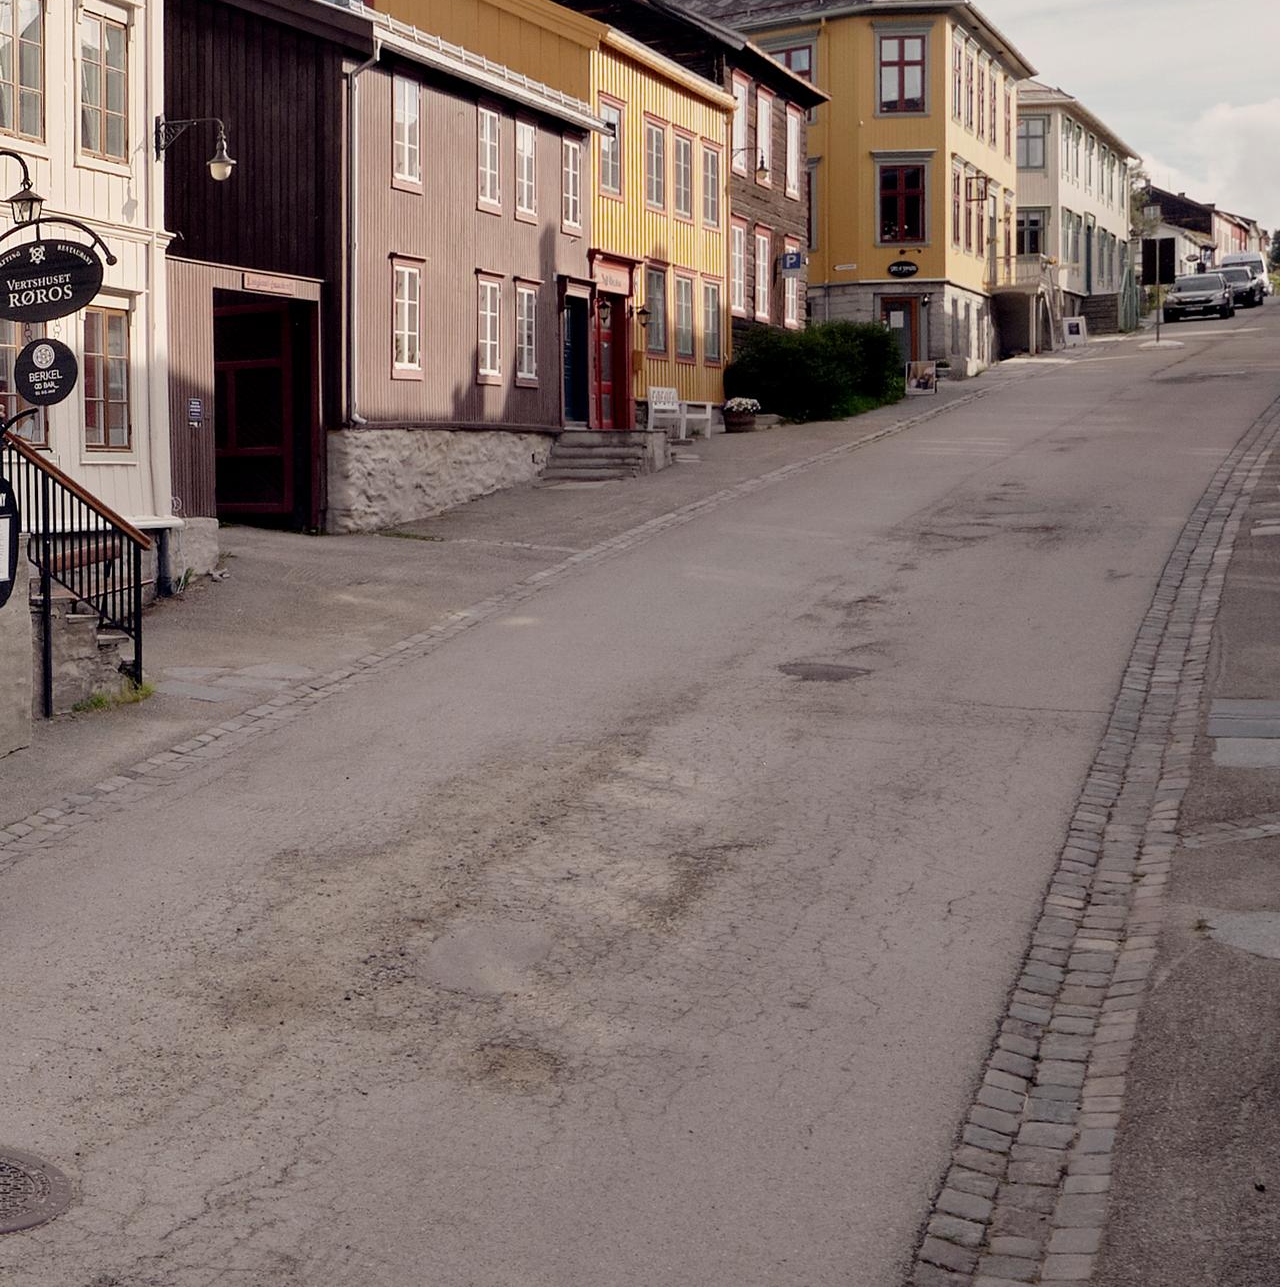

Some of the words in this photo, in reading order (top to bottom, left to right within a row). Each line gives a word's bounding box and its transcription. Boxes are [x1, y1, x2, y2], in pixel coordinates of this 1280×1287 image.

[57, 244, 93, 265] RESTAURANT
[786, 255, 797, 268] P
[7, 273, 71, 291] VERTSHUSET
[8, 284, 73, 307] RØROS
[29, 369, 62, 382] BERKEL
